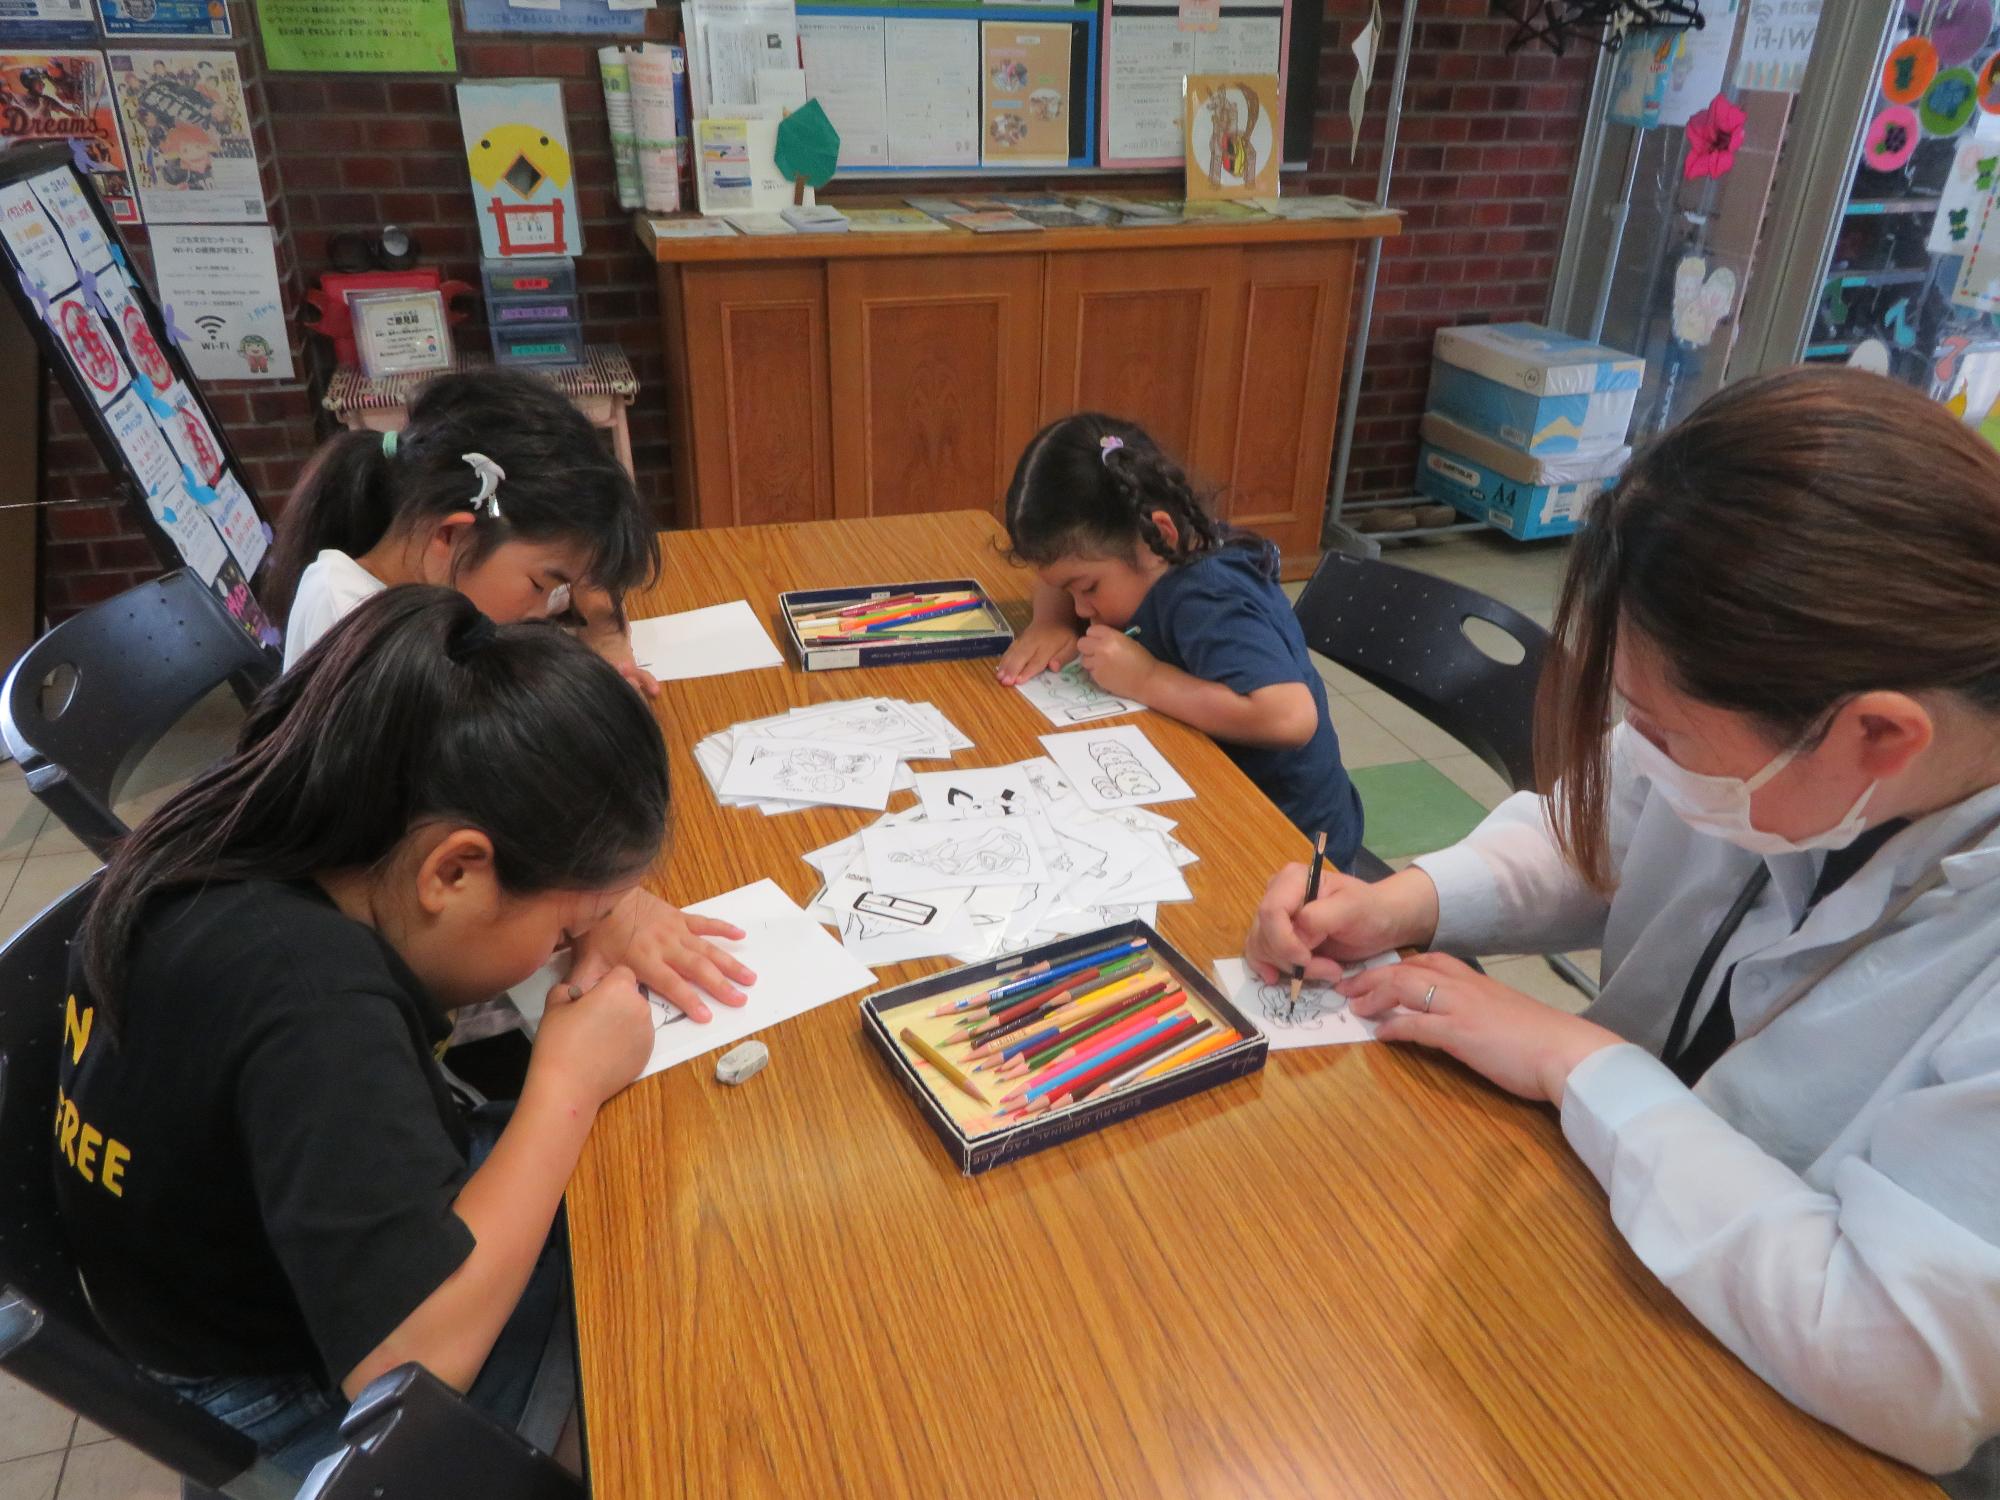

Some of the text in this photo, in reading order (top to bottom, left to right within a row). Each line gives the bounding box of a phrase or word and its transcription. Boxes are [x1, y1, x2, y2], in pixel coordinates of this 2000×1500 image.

[1, 106, 109, 139] Dreams
[201, 341, 231, 351] Wi-Fi
[1494, 482, 1517, 507] A4
